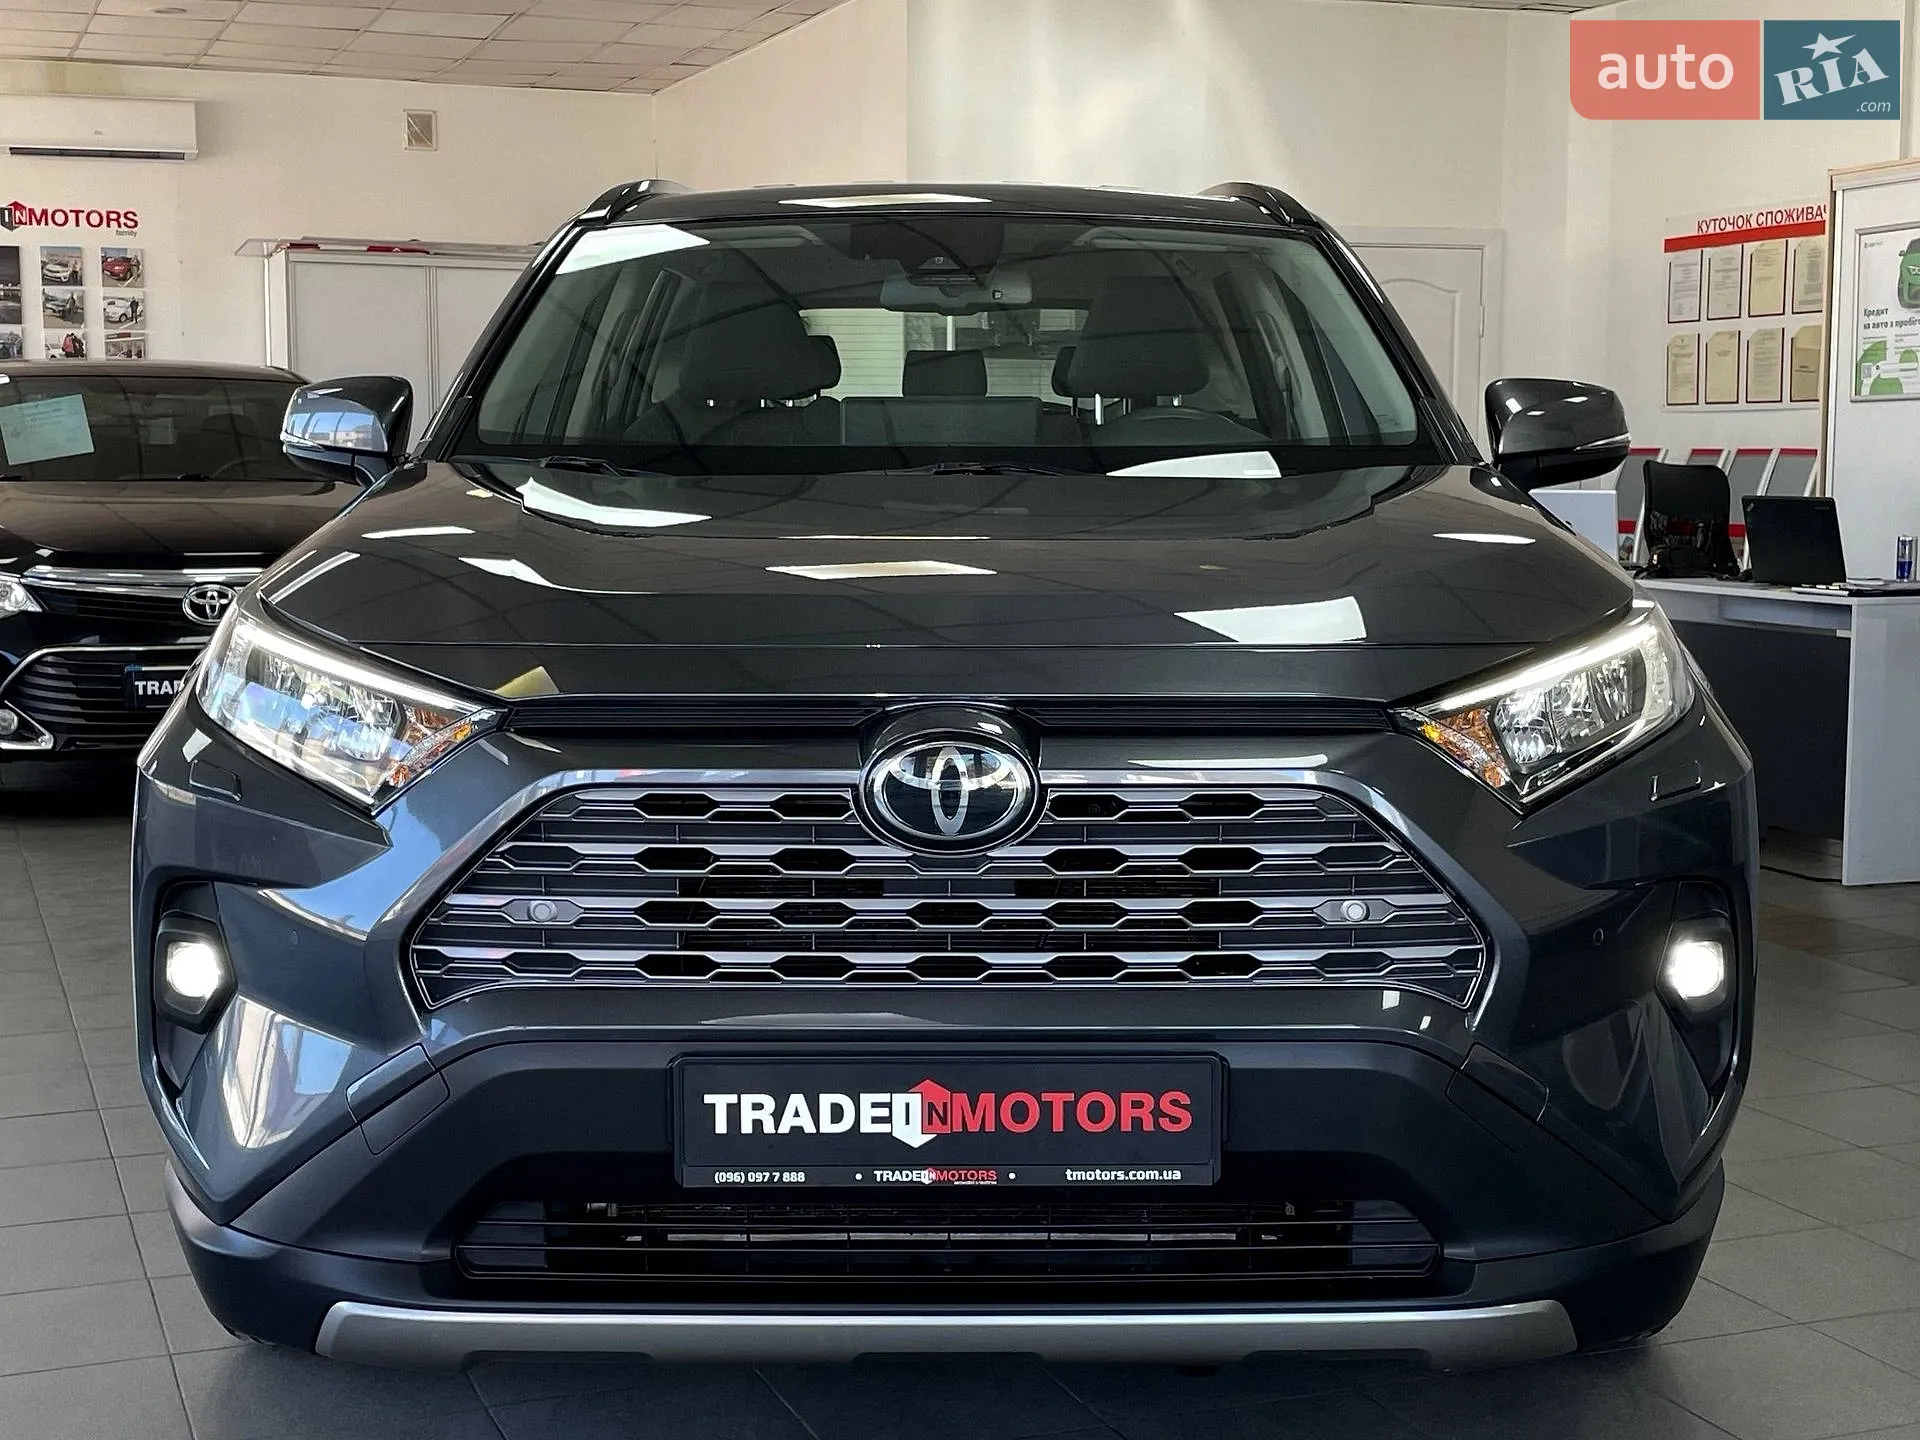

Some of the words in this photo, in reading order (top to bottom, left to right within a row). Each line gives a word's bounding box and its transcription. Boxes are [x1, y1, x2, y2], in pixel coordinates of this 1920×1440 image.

[1697, 213, 1754, 234] КУТОЧОК
[1863, 308, 1889, 318] Кредит
[714, 1171, 745, 1184] (096)
[747, 1171, 770, 1183] 097
[772, 1171, 781, 1183] 7
[782, 1171, 806, 1183] 888
[1065, 1168, 1182, 1181] tmotors.com.ua
